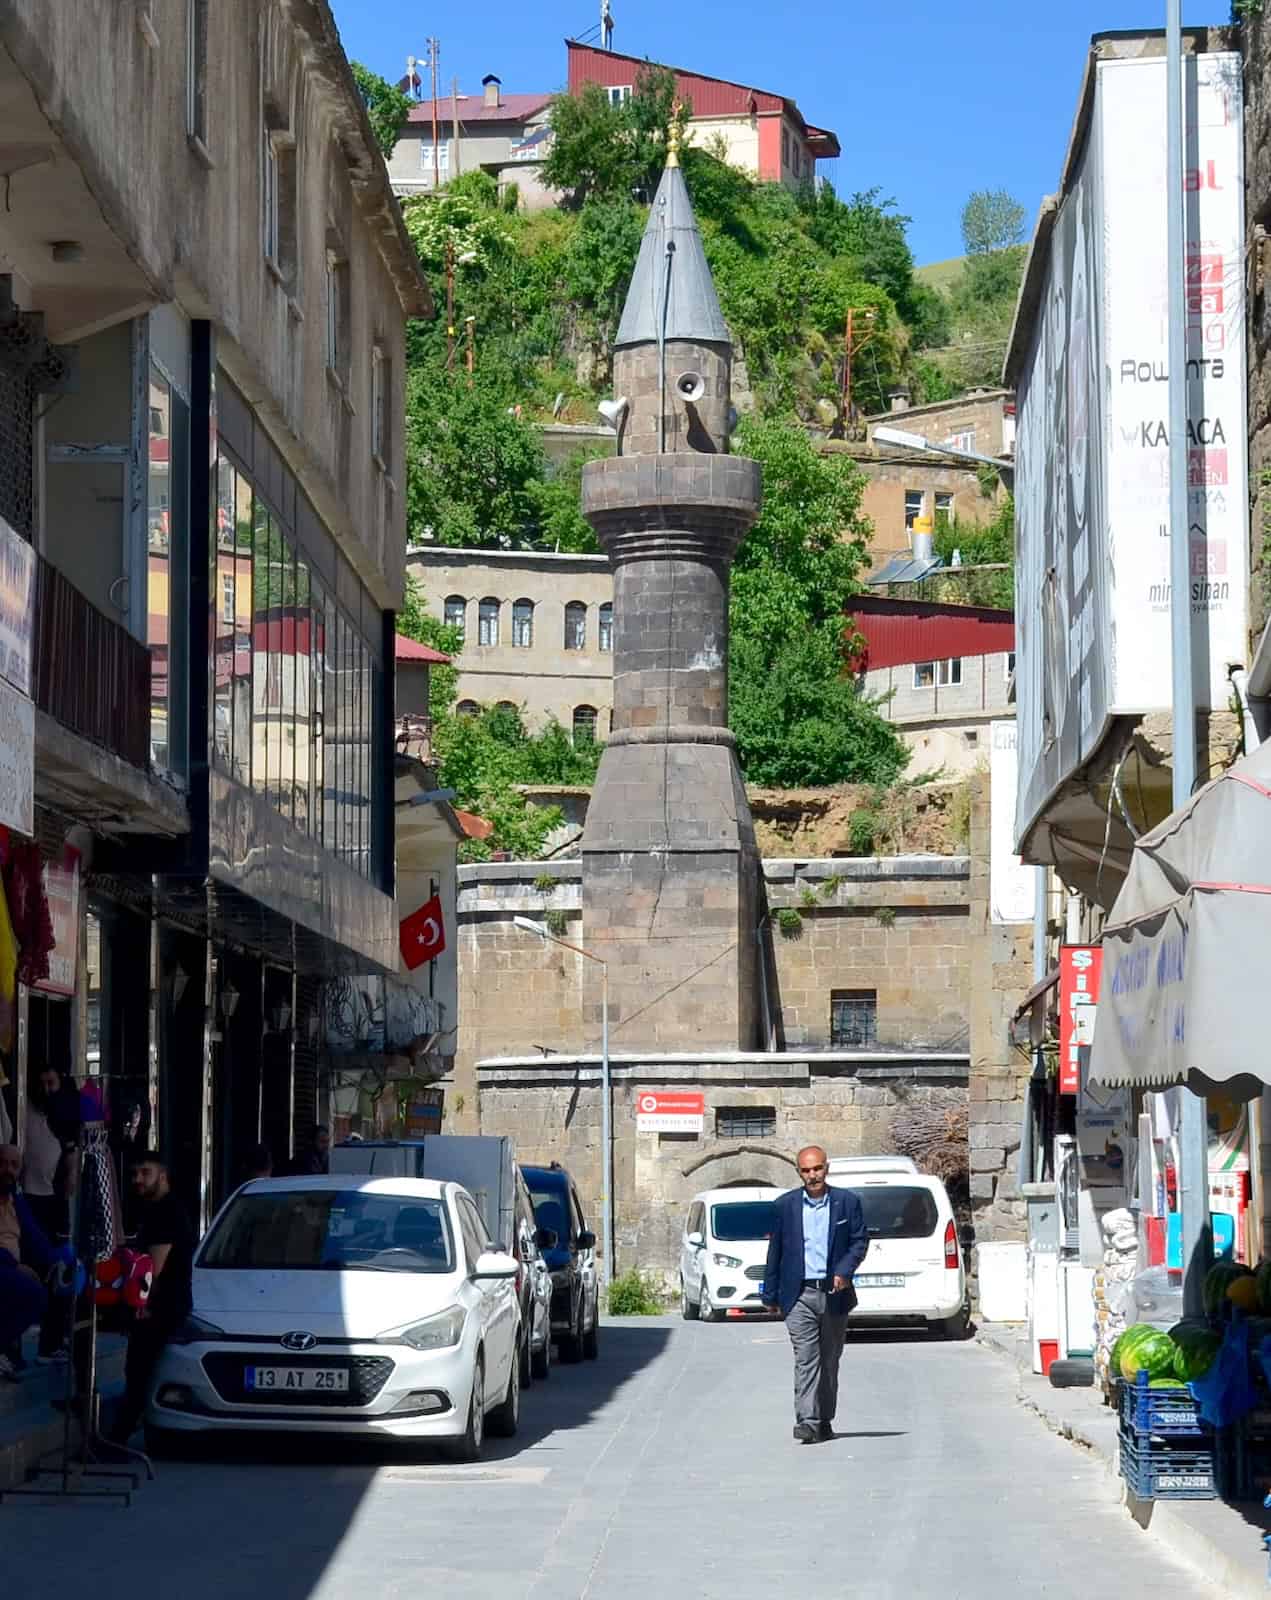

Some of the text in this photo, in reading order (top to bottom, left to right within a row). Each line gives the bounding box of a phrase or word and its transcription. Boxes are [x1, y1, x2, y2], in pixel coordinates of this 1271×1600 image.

[1141, 418, 1226, 448] KAACA
[258, 1370, 276, 1387] 13
[285, 1370, 305, 1388] AT
